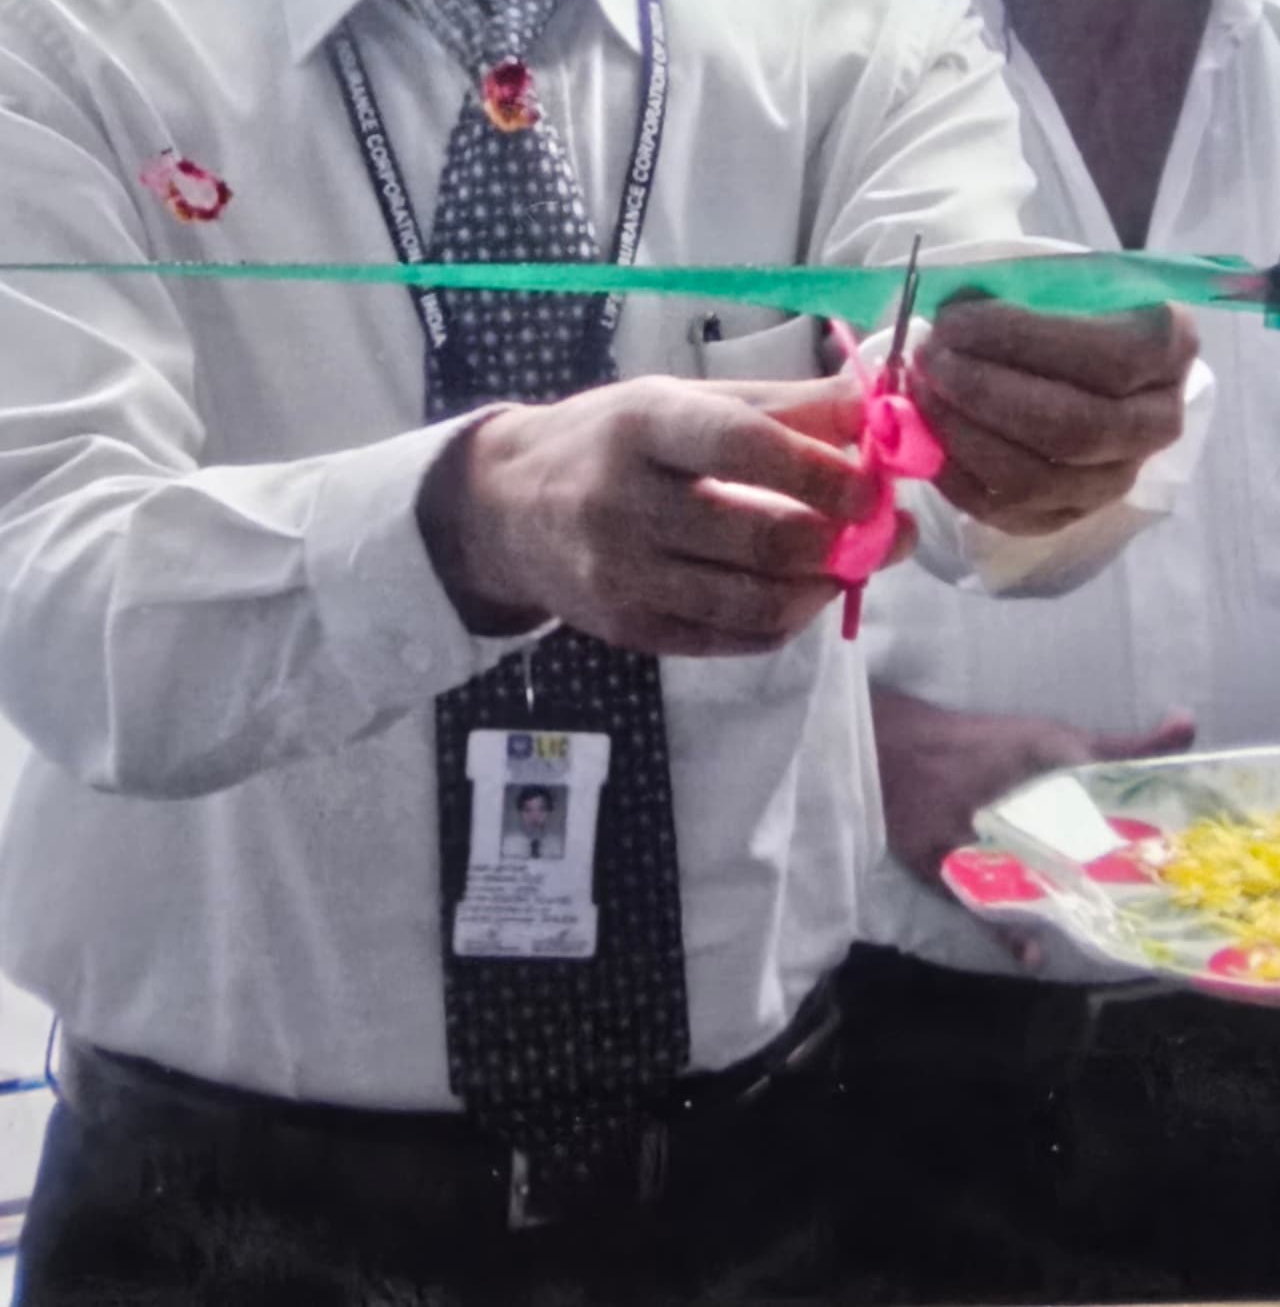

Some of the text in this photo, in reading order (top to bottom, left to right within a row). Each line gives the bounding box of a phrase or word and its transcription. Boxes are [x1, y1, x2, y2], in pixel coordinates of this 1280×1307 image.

[633, 65, 665, 183] CORPORATION
[365, 134, 422, 262] CORPORATION
[421, 295, 448, 348] INDIA
